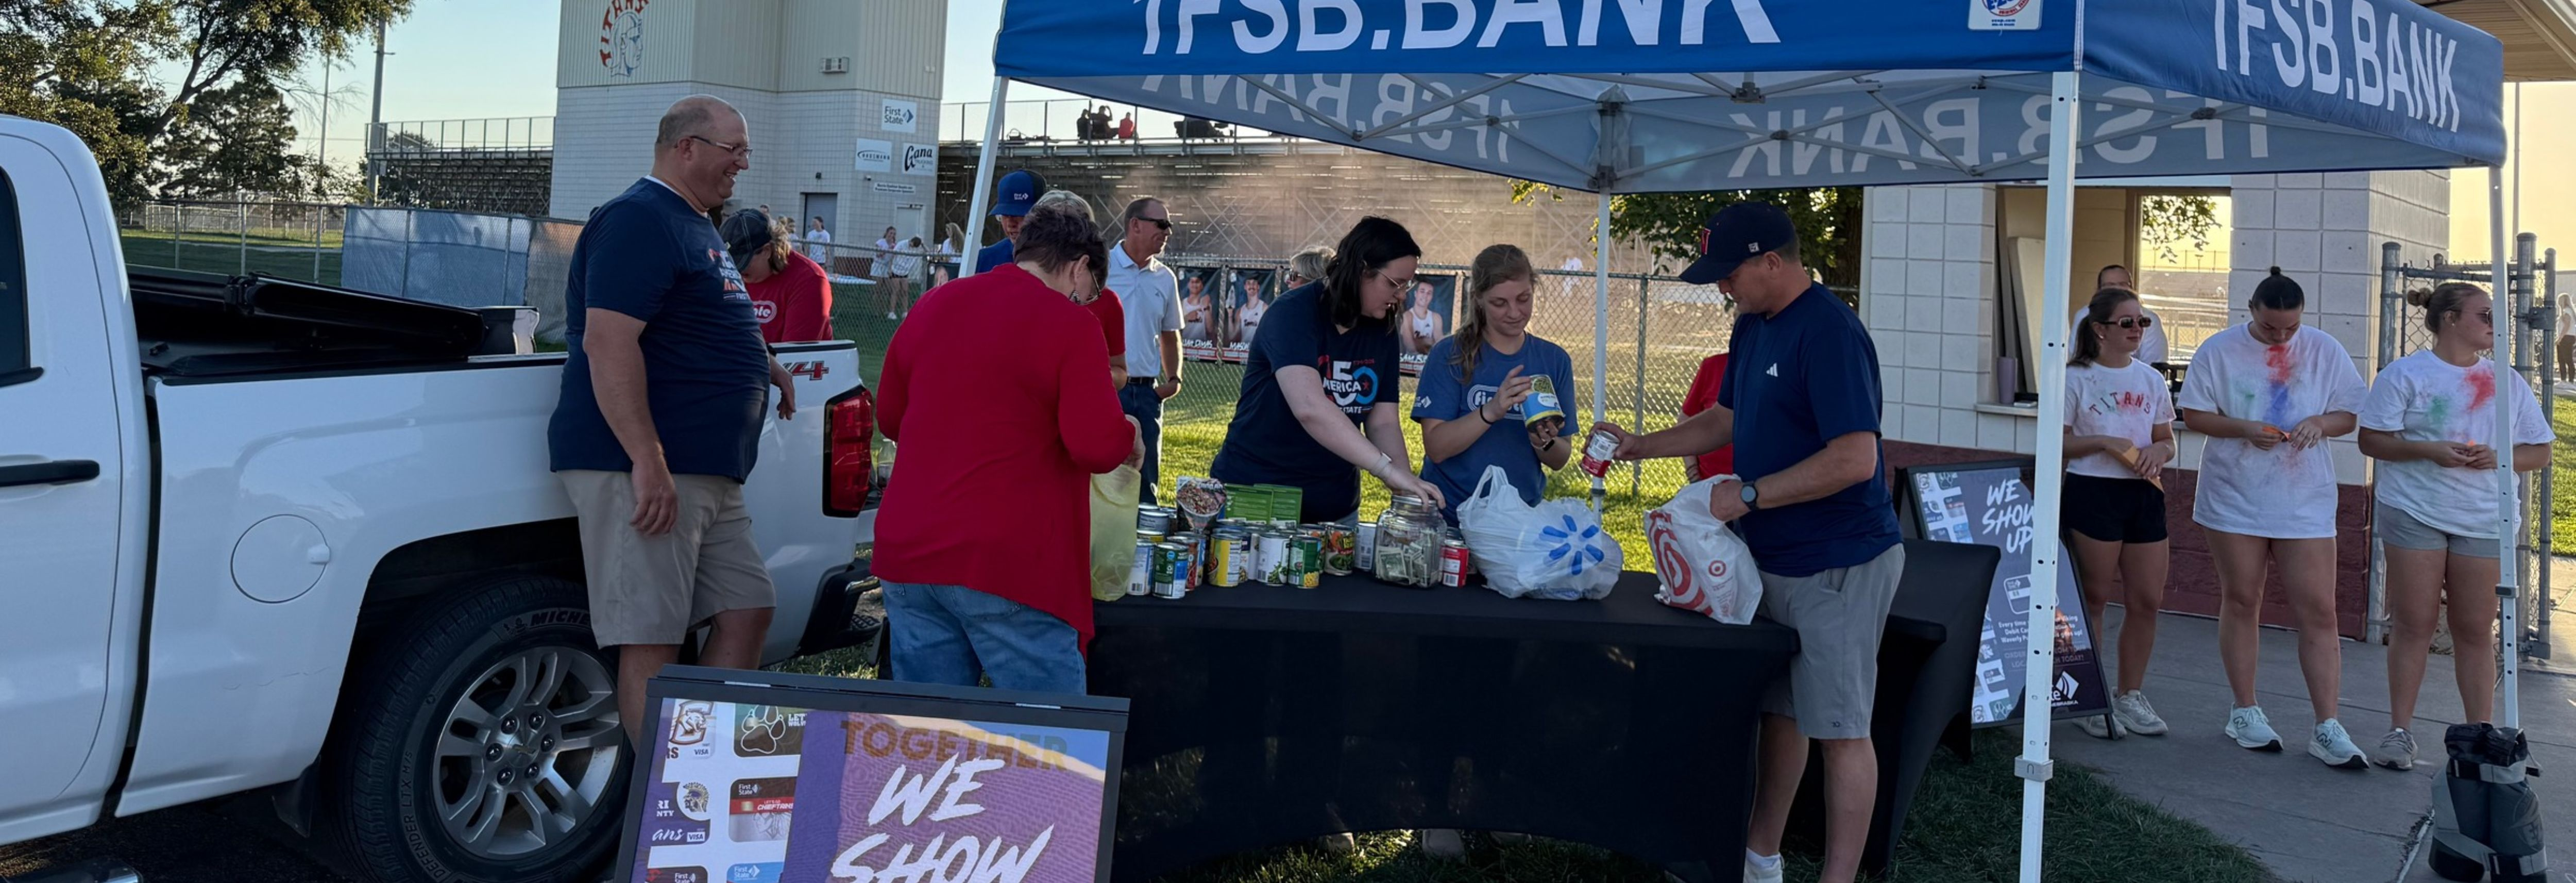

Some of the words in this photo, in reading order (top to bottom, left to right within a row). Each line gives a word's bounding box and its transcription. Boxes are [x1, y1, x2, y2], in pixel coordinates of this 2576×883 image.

[884, 114, 903, 125] State
[885, 106, 901, 115] First
[905, 145, 933, 172] Gana
[1323, 377, 1361, 392] MERICA
[2089, 391, 2151, 414] TITANS
[1987, 478, 2021, 507] WE
[2006, 526, 2033, 554] UP
[531, 610, 590, 626] MICHE
[2001, 635, 2022, 643] Waverly
[840, 720, 1067, 771] TOGETHER
[401, 780, 412, 807] LTX
[868, 752, 1005, 826] WE
[404, 815, 446, 879] DEFENDER
[831, 823, 1055, 883] SHOW
